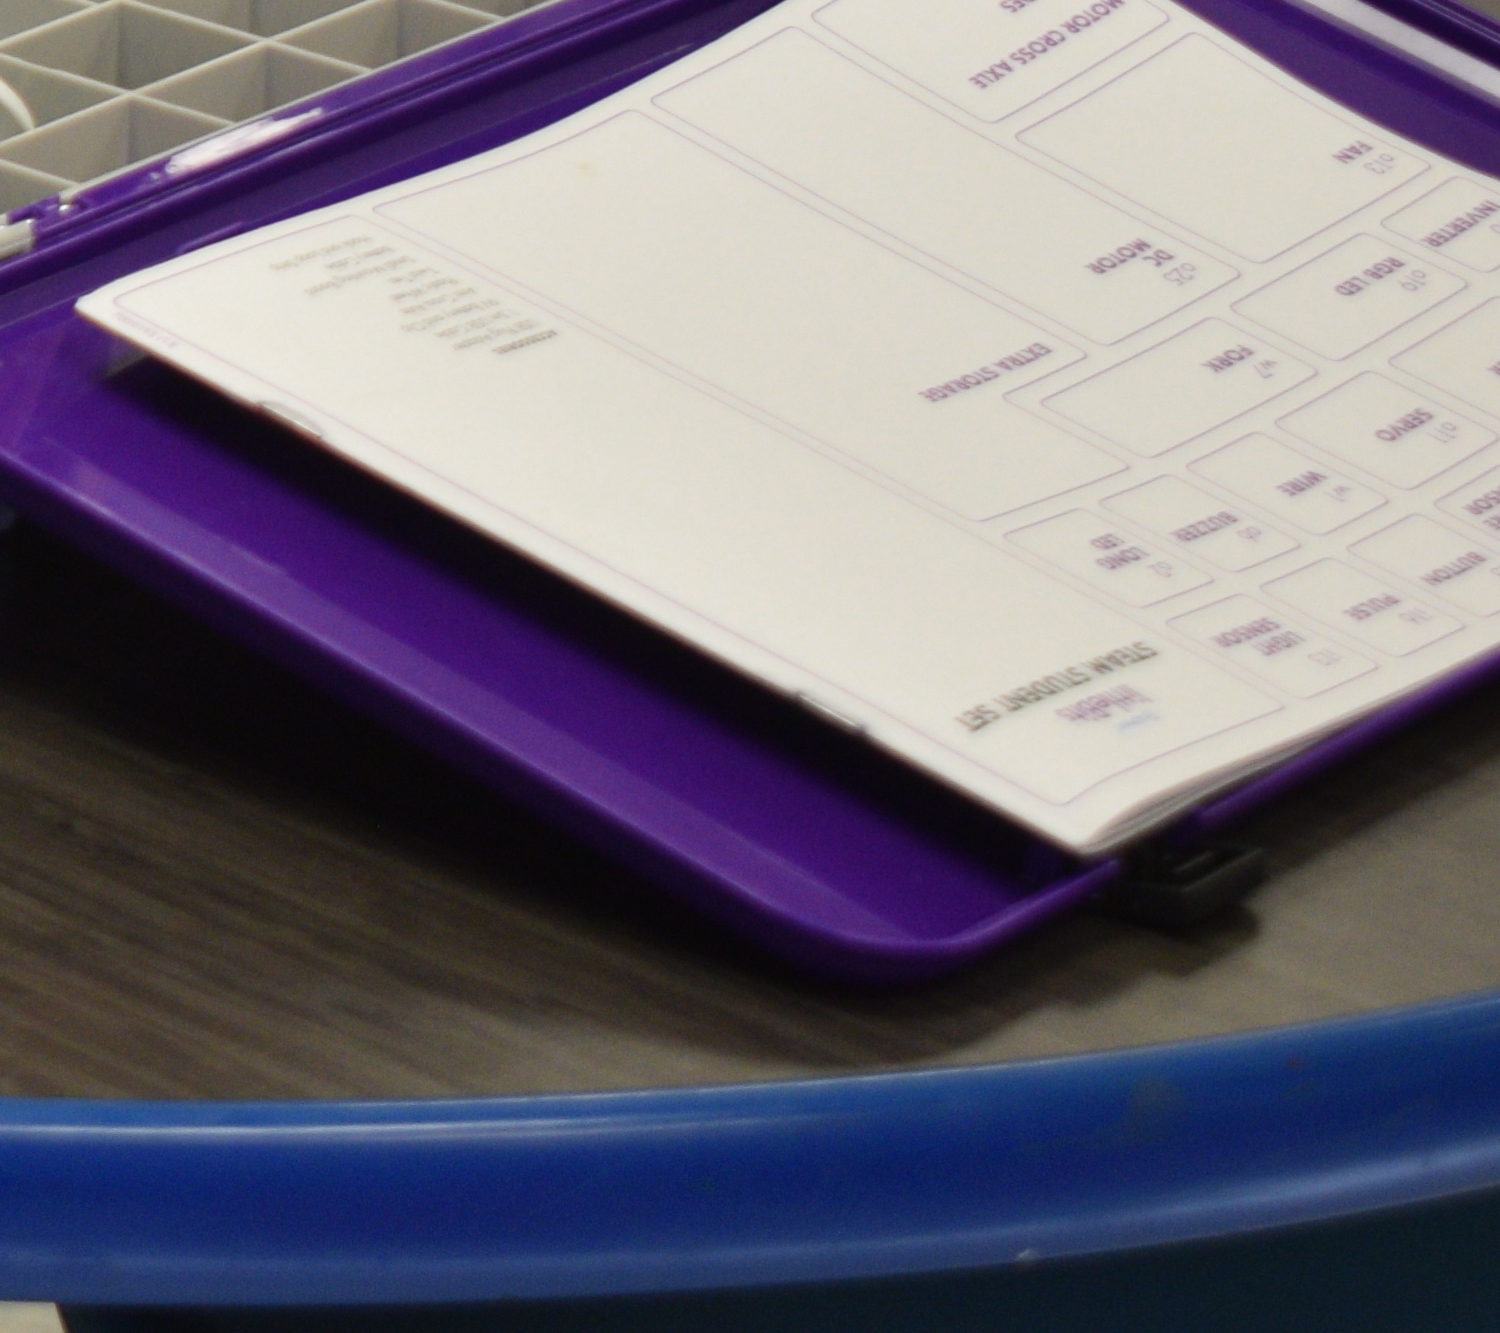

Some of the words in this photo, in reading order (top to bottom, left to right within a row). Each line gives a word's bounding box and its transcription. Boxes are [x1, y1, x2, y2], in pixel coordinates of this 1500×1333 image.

[1009, 30, 1066, 65] CROSS
[968, 59, 1014, 89] AXLE
[1332, 141, 1374, 164] FAN
[1420, 199, 1500, 247] INVERTER
[1084, 238, 1152, 275] MOTOR
[1141, 248, 1175, 267] DC
[1362, 256, 1406, 280] RGB
[1334, 275, 1370, 297] LED
[992, 341, 1053, 373] EXTRA
[1200, 343, 1256, 373] FORK
[917, 366, 1001, 403] STORAGE
[1373, 407, 1435, 442] SERVO
[1275, 470, 1328, 498] WIRE
[1168, 510, 1240, 542] BUZZER
[1094, 546, 1151, 571] LONG
[1419, 550, 1489, 586] BUTTON
[1342, 592, 1402, 621] PULSE
[1208, 615, 1283, 648] SENSOR
[1249, 629, 1307, 657] LIGHT
[1080, 640, 1160, 675] STEAM
[993, 665, 1094, 713] STUDENT
[952, 702, 1002, 734] SET
